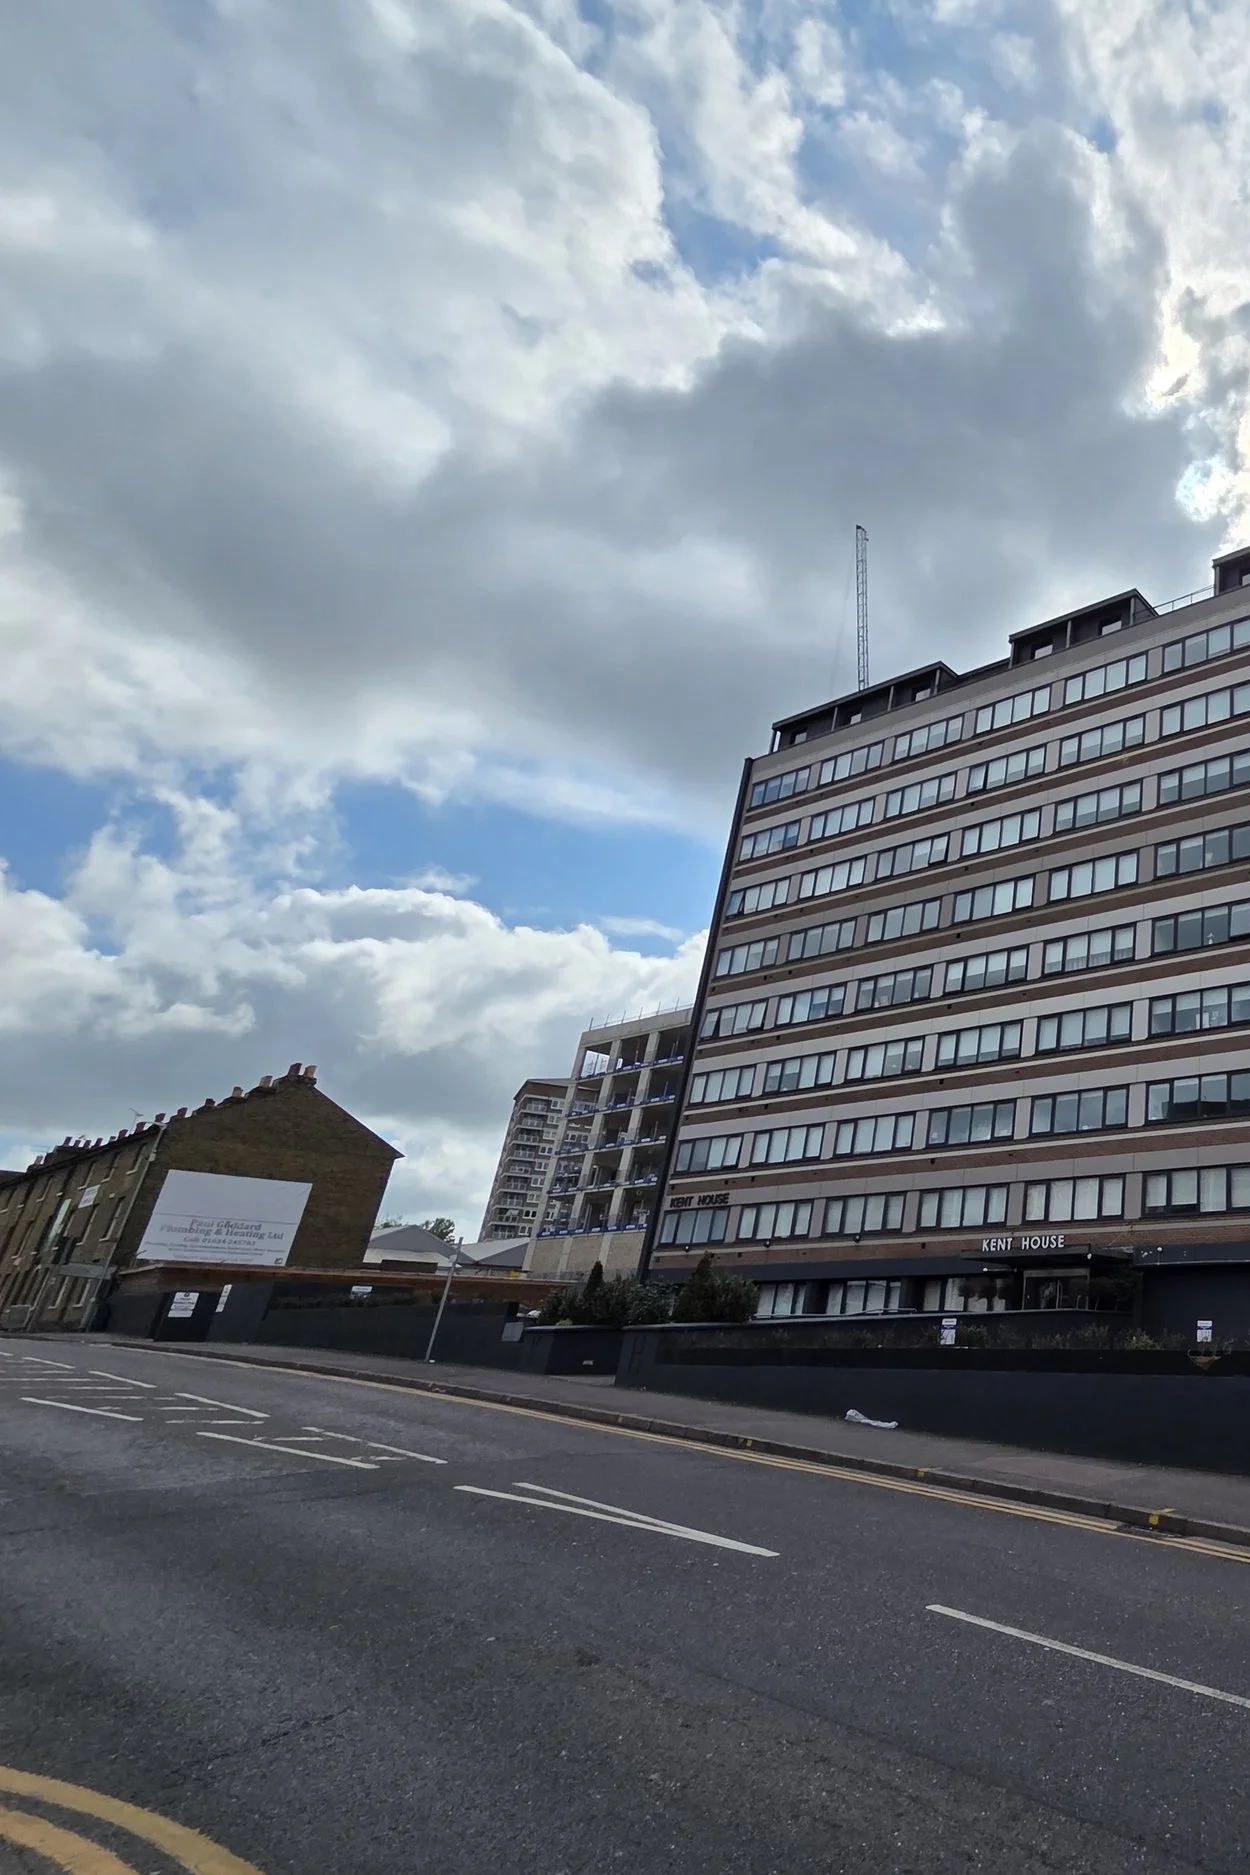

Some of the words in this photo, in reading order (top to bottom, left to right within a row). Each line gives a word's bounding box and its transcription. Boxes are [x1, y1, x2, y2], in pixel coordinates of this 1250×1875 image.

[670, 1196, 694, 1208] KENT
[697, 1193, 730, 1206] HOUSE
[225, 1229, 265, 1240] Heating
[267, 1232, 284, 1240] Ltd
[982, 1238, 1013, 1252] KENT
[1021, 1235, 1065, 1250] HOUSE
